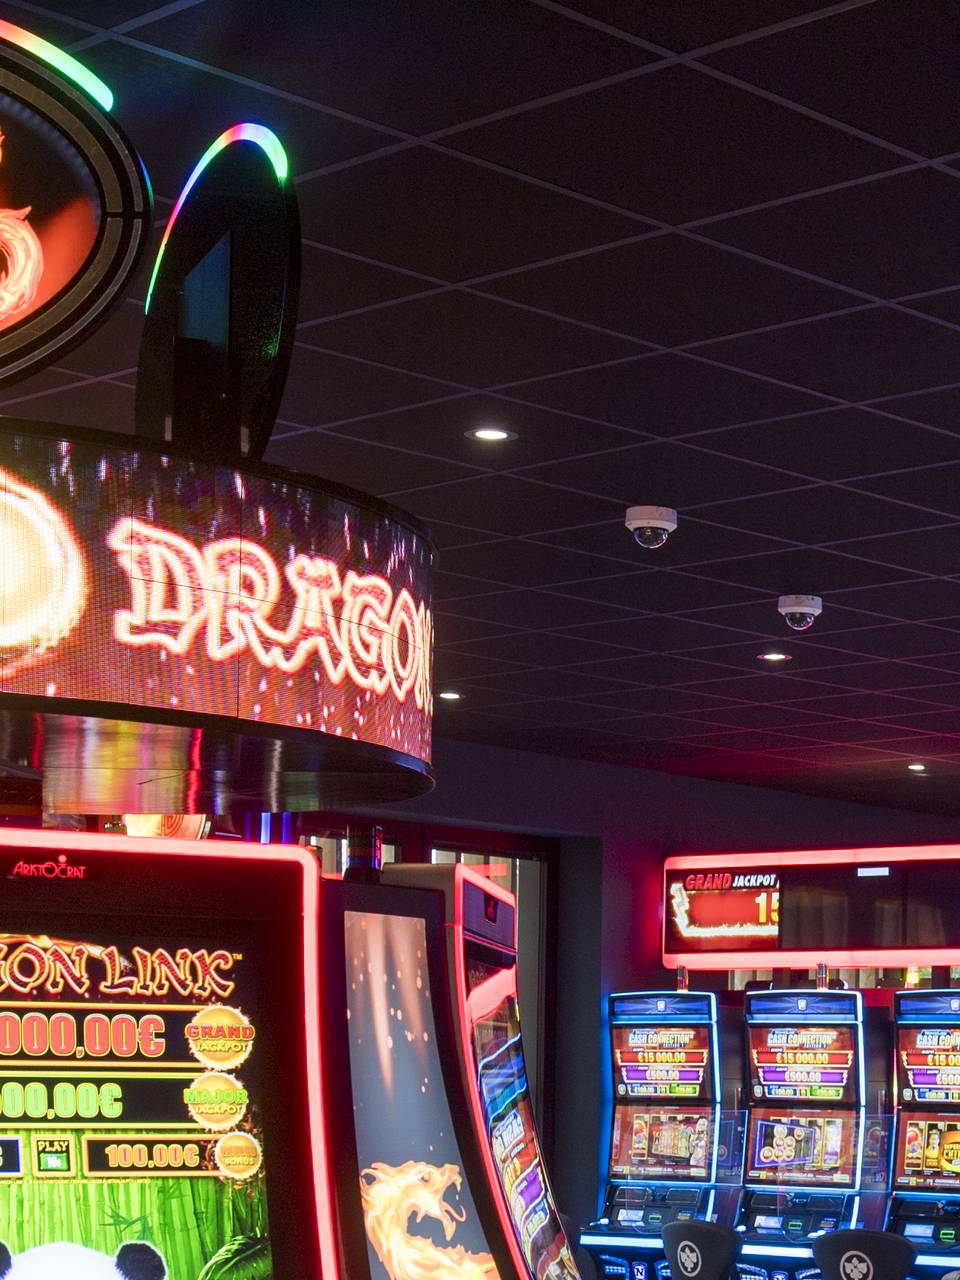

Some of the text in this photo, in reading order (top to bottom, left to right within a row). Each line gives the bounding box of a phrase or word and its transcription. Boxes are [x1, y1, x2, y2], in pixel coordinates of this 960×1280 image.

[685, 872, 776, 890] GRAND JACKPOT
[100, 946, 234, 996] LINK
[184, 1023, 255, 1041] GRAND
[196, 1041, 248, 1052] JACKPOT
[184, 1088, 249, 1104] MAJOR
[194, 1104, 242, 1115] JACKPOT
[37, 1140, 69, 1152] PLAY
[104, 1144, 199, 1169] 100,00€
